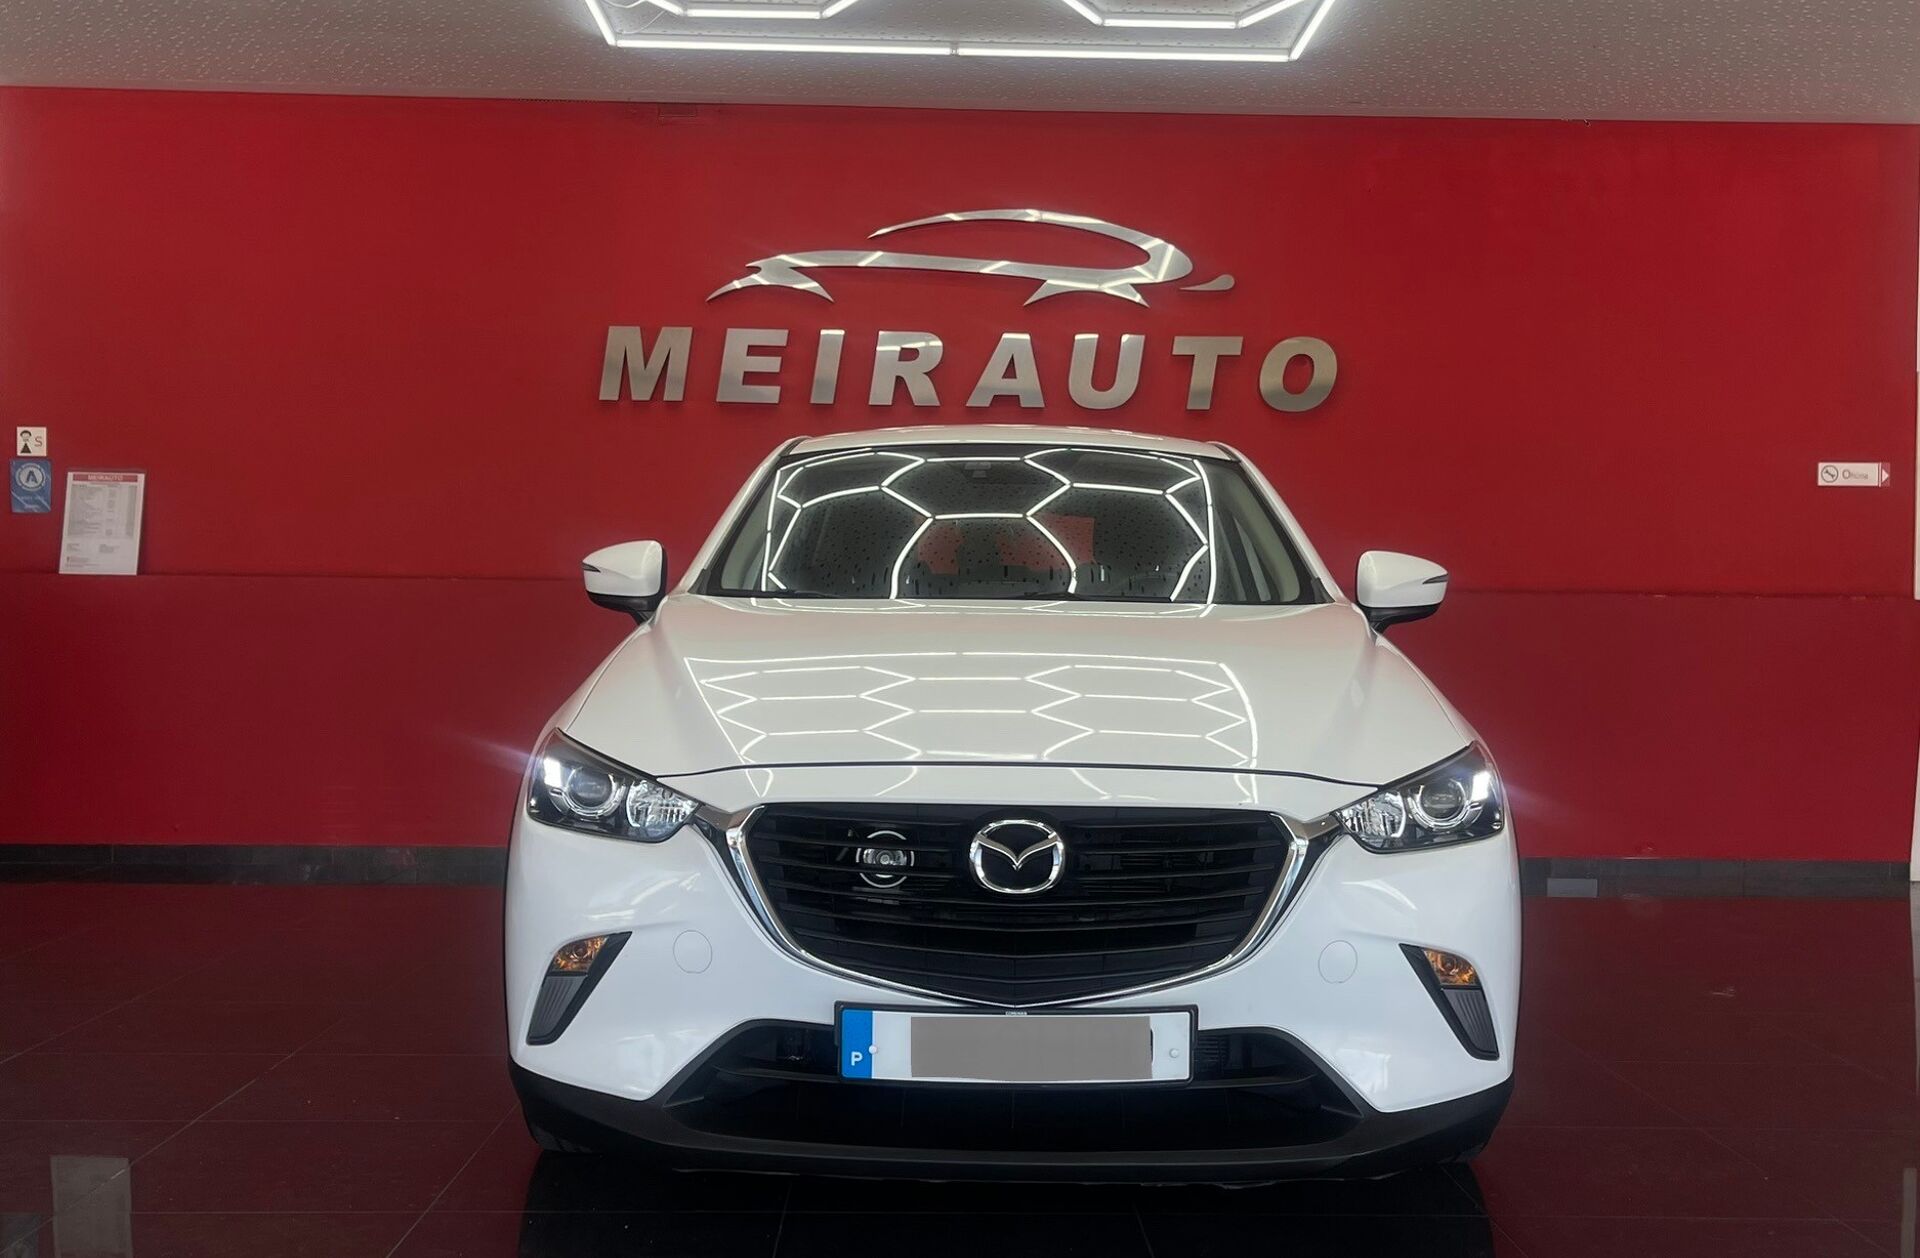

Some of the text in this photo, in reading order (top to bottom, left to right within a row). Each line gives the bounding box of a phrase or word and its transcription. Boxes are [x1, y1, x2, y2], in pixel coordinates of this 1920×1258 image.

[599, 325, 1339, 412] MEIRAUTO
[26, 470, 38, 484] A
[850, 1051, 863, 1066] P
